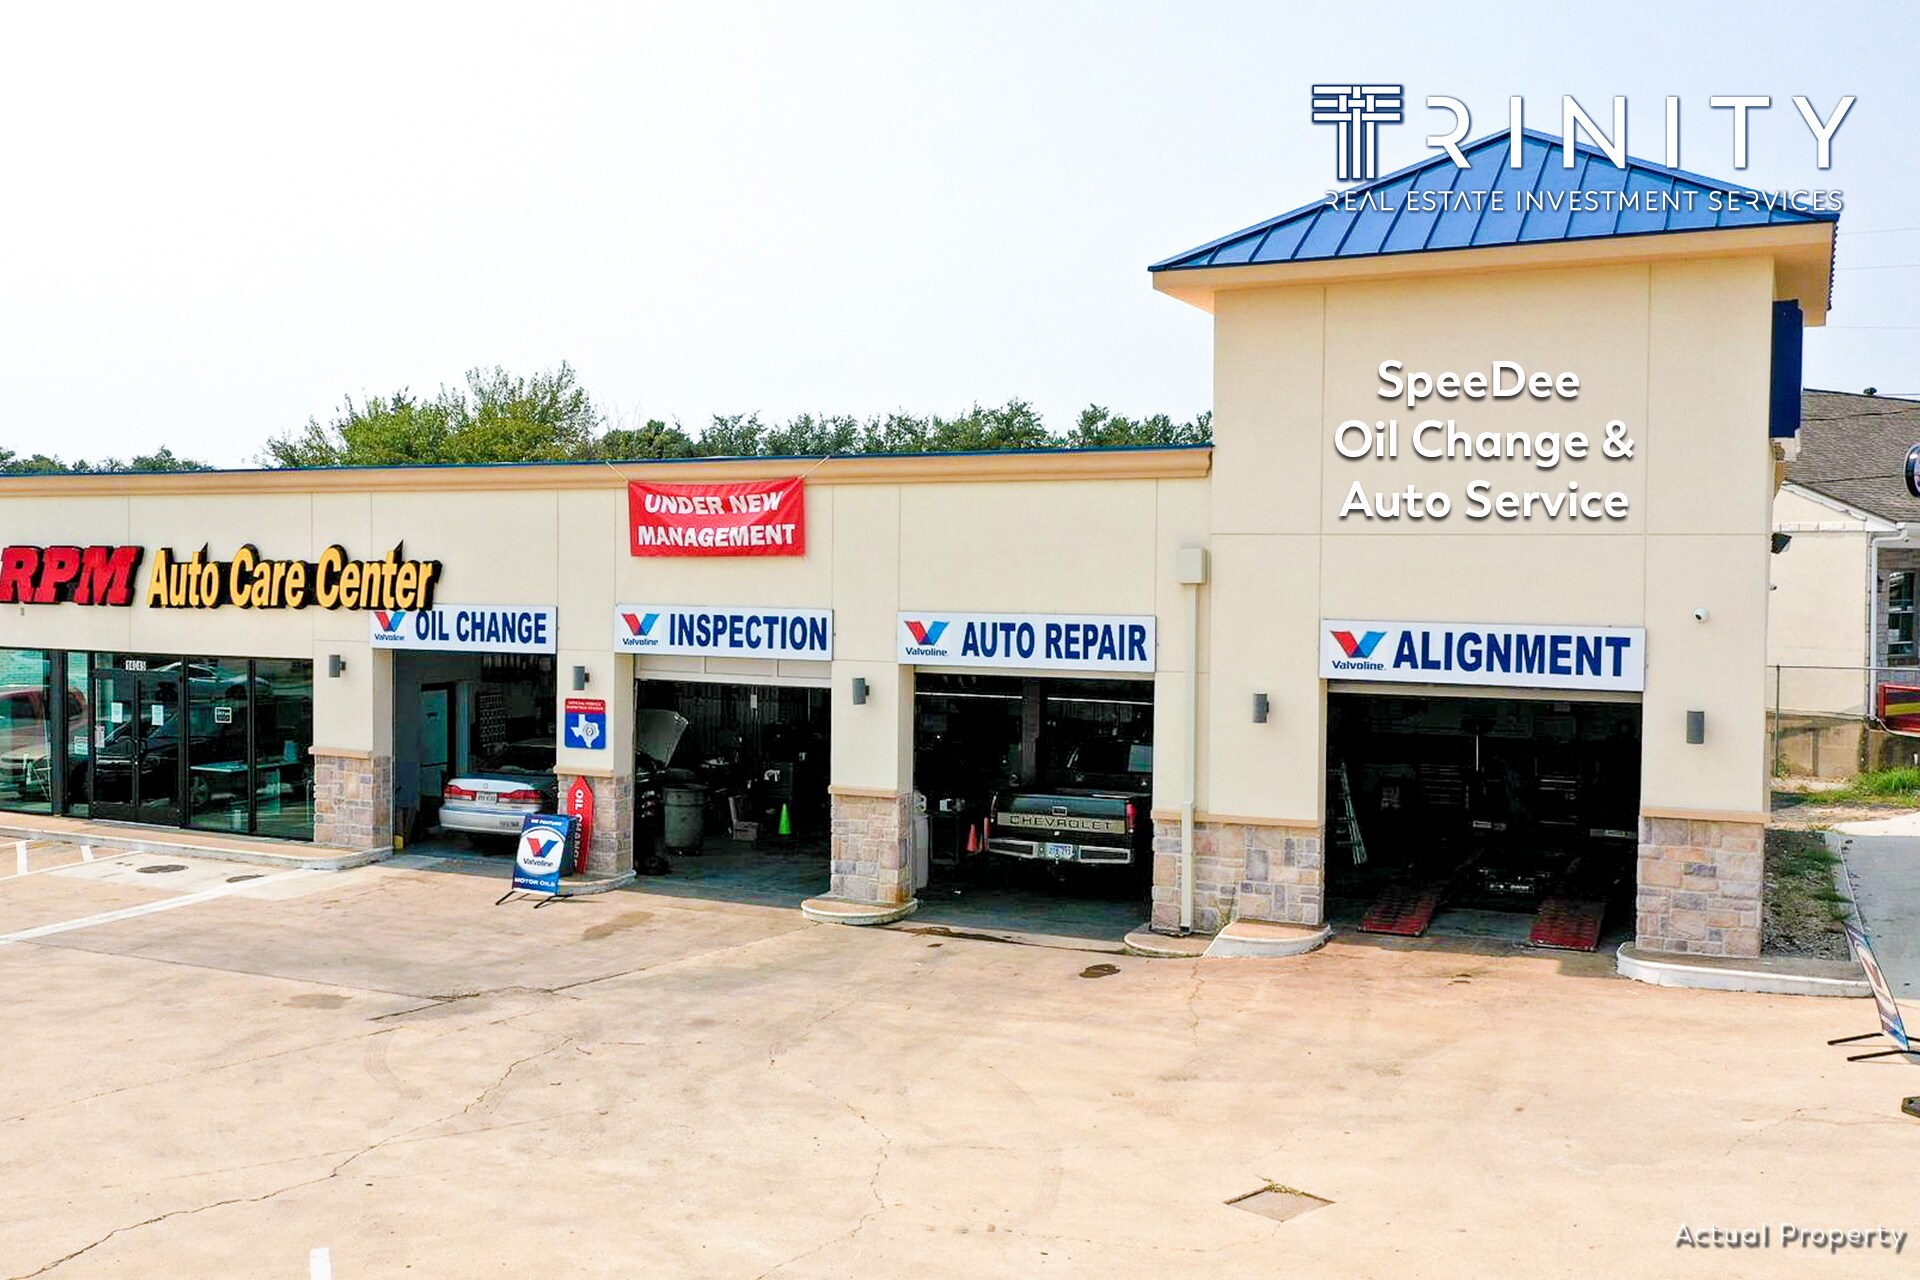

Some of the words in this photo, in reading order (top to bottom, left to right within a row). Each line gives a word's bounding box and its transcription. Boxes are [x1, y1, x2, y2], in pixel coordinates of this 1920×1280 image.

[644, 494, 725, 515] UNDER
[729, 491, 783, 514] NEW
[638, 524, 795, 547] MANAGEMENT
[0, 546, 142, 606] RPM
[148, 545, 220, 608] Auto
[230, 545, 306, 609] Care
[316, 543, 438, 610] Center
[416, 610, 449, 641] OIL
[456, 611, 547, 644] CHANGE
[669, 613, 827, 650] INSPECTION
[622, 638, 659, 646] Valvoline
[906, 647, 949, 657] Valvoline
[961, 622, 1035, 658] AUTO
[1046, 623, 1147, 661] REPAIR
[1393, 630, 1631, 677] ALIGNMENT
[1332, 660, 1386, 671] Valvoline
[575, 789, 584, 810] OIL
[1010, 815, 1113, 830] CHEVROLET
[523, 858, 553, 867] Valvoline
[514, 877, 539, 886] MOTOR
